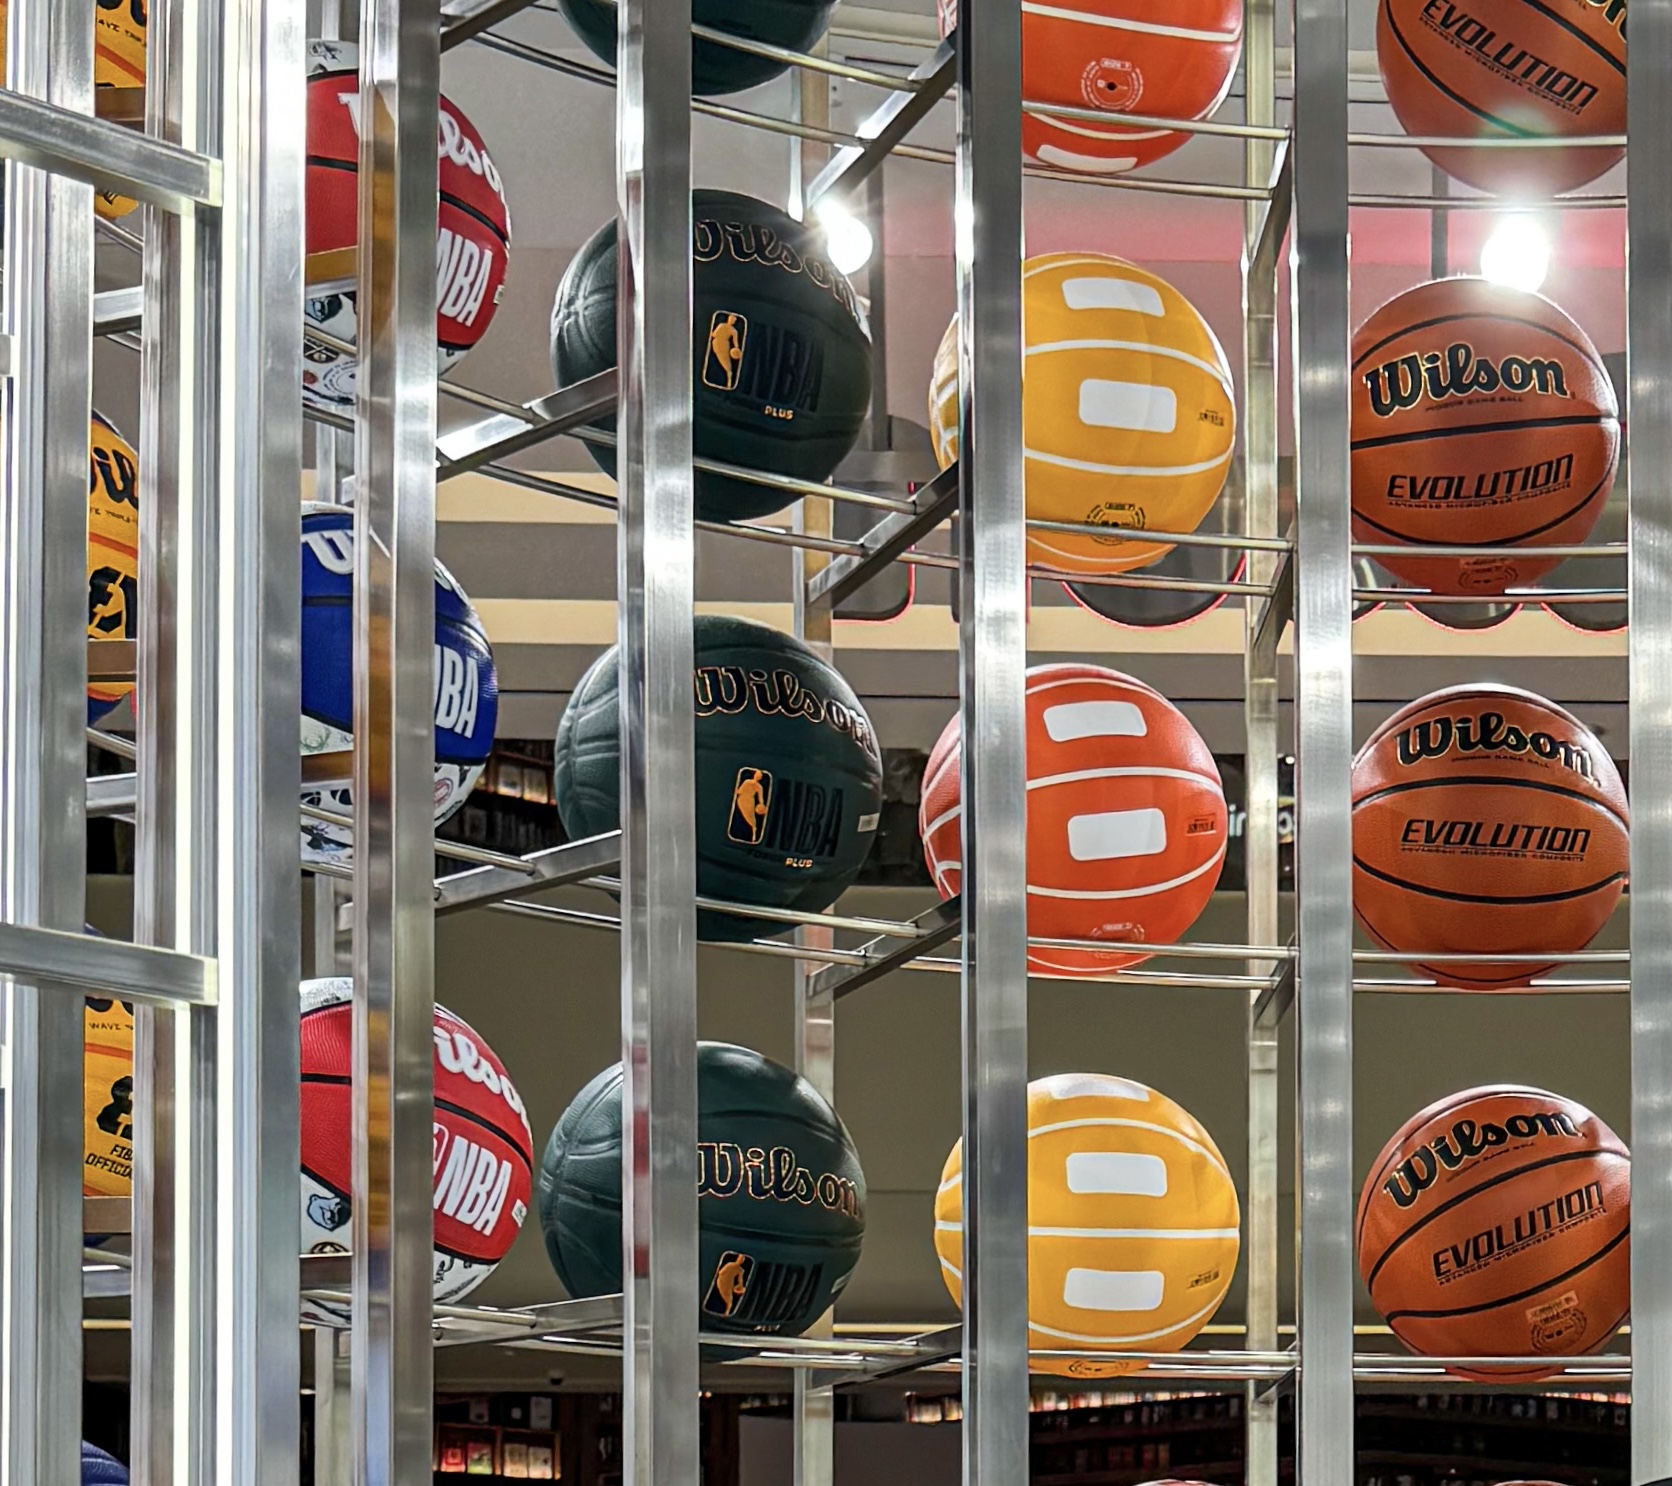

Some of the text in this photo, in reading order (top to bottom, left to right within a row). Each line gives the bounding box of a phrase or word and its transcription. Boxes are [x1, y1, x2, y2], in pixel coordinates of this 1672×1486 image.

[1421, 0, 1598, 107] EVOLUTION
[764, 404, 794, 421] PLUS
[1363, 343, 1572, 417] Wilson
[1387, 453, 1574, 500] EVOLUTION
[694, 665, 877, 762] Wilson
[1394, 712, 1596, 786] Wilson
[768, 778, 845, 858] NBA
[1401, 818, 1591, 853] EVOLUTION
[785, 856, 813, 869] PLUS
[110, 1144, 133, 1161] FIB
[434, 1135, 512, 1237] NBA
[697, 1142, 860, 1218] Wilson
[1383, 1112, 1582, 1210] Wilson
[1432, 1180, 1604, 1278] EVOLUTION
[751, 1261, 823, 1324] NBA
